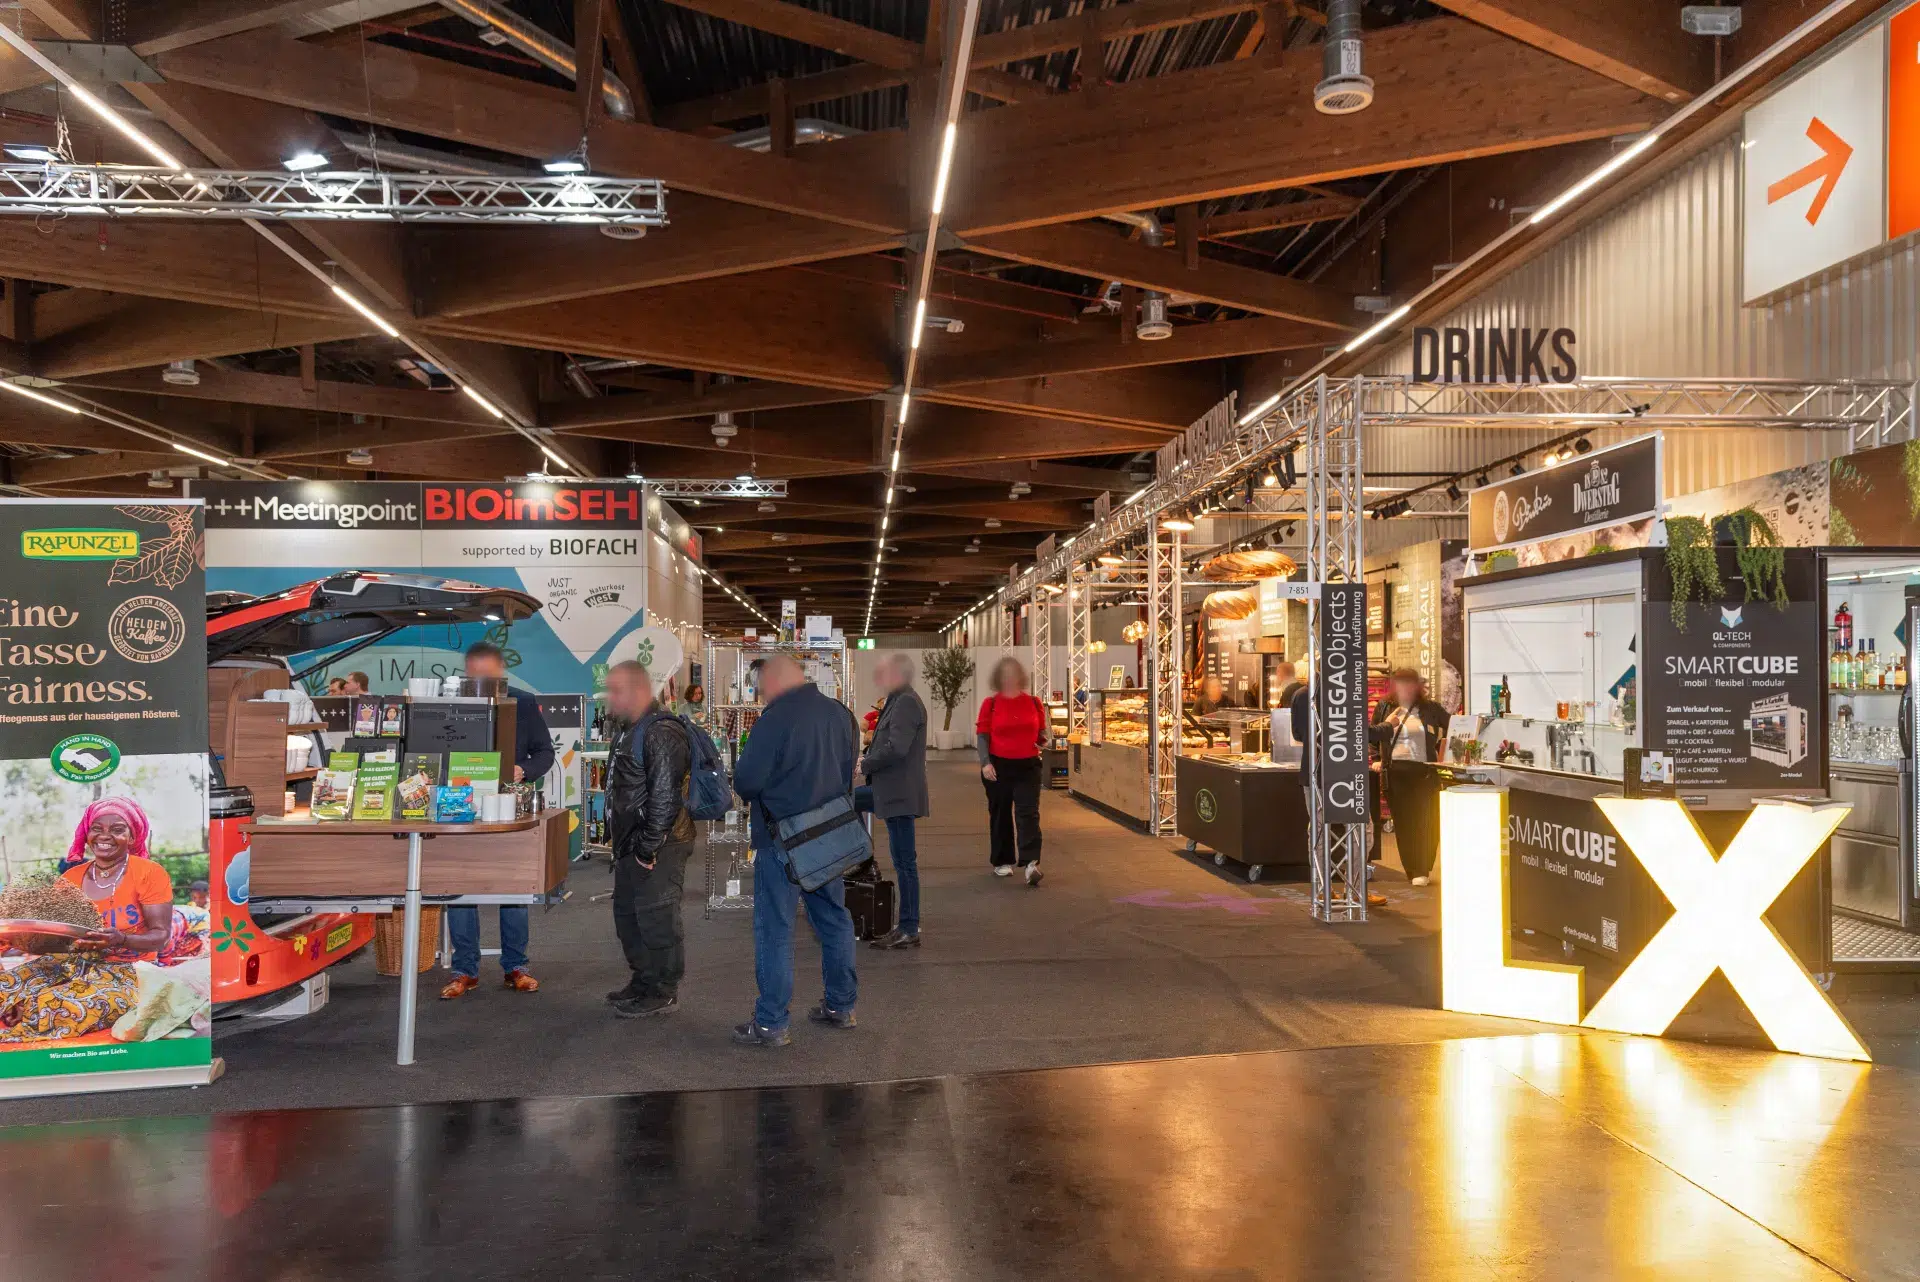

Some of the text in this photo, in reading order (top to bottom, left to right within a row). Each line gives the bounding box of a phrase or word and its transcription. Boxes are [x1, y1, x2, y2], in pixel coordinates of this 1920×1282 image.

[1413, 327, 1577, 384] DRINKS
[1573, 472, 1620, 514] DWERSTEG
[426, 488, 638, 520] BIOimSEH
[27, 536, 134, 553] RAPUNZEL
[462, 539, 638, 558] supported by BIOFACH
[548, 578, 572, 588] JUST
[589, 584, 625, 594] Naturkost
[1288, 586, 1309, 594] 7-851
[550, 588, 578, 598] ORGANIC
[587, 593, 613, 606] West
[128, 599, 153, 608] HELDEN
[154, 600, 180, 623] ANGEBAUT
[1352, 591, 1364, 648] Ausführung
[126, 617, 167, 631] HELDEN
[126, 628, 167, 645] Kaffee
[1712, 631, 1751, 641] QL-TECH
[150, 641, 177, 660] RAPUNZEL
[380, 658, 415, 681] IM
[1665, 656, 1799, 674] SMARTCUBE
[1327, 591, 1351, 762] OMEGAObjects
[1353, 660, 1364, 702] Planung
[1684, 678, 1785, 687] mobil flexibel modular
[68, 713, 82, 721] der
[85, 712, 140, 722] hauseigenen
[142, 710, 180, 719] Rösterei.
[60, 737, 80, 749] HAND
[91, 736, 111, 748] HAND
[1353, 713, 1363, 762] Ladenbau
[1355, 774, 1364, 815] OBJECTS
[1508, 814, 1617, 867] SMARTCUBE
[1521, 853, 1605, 886] mobil flexibel modular
